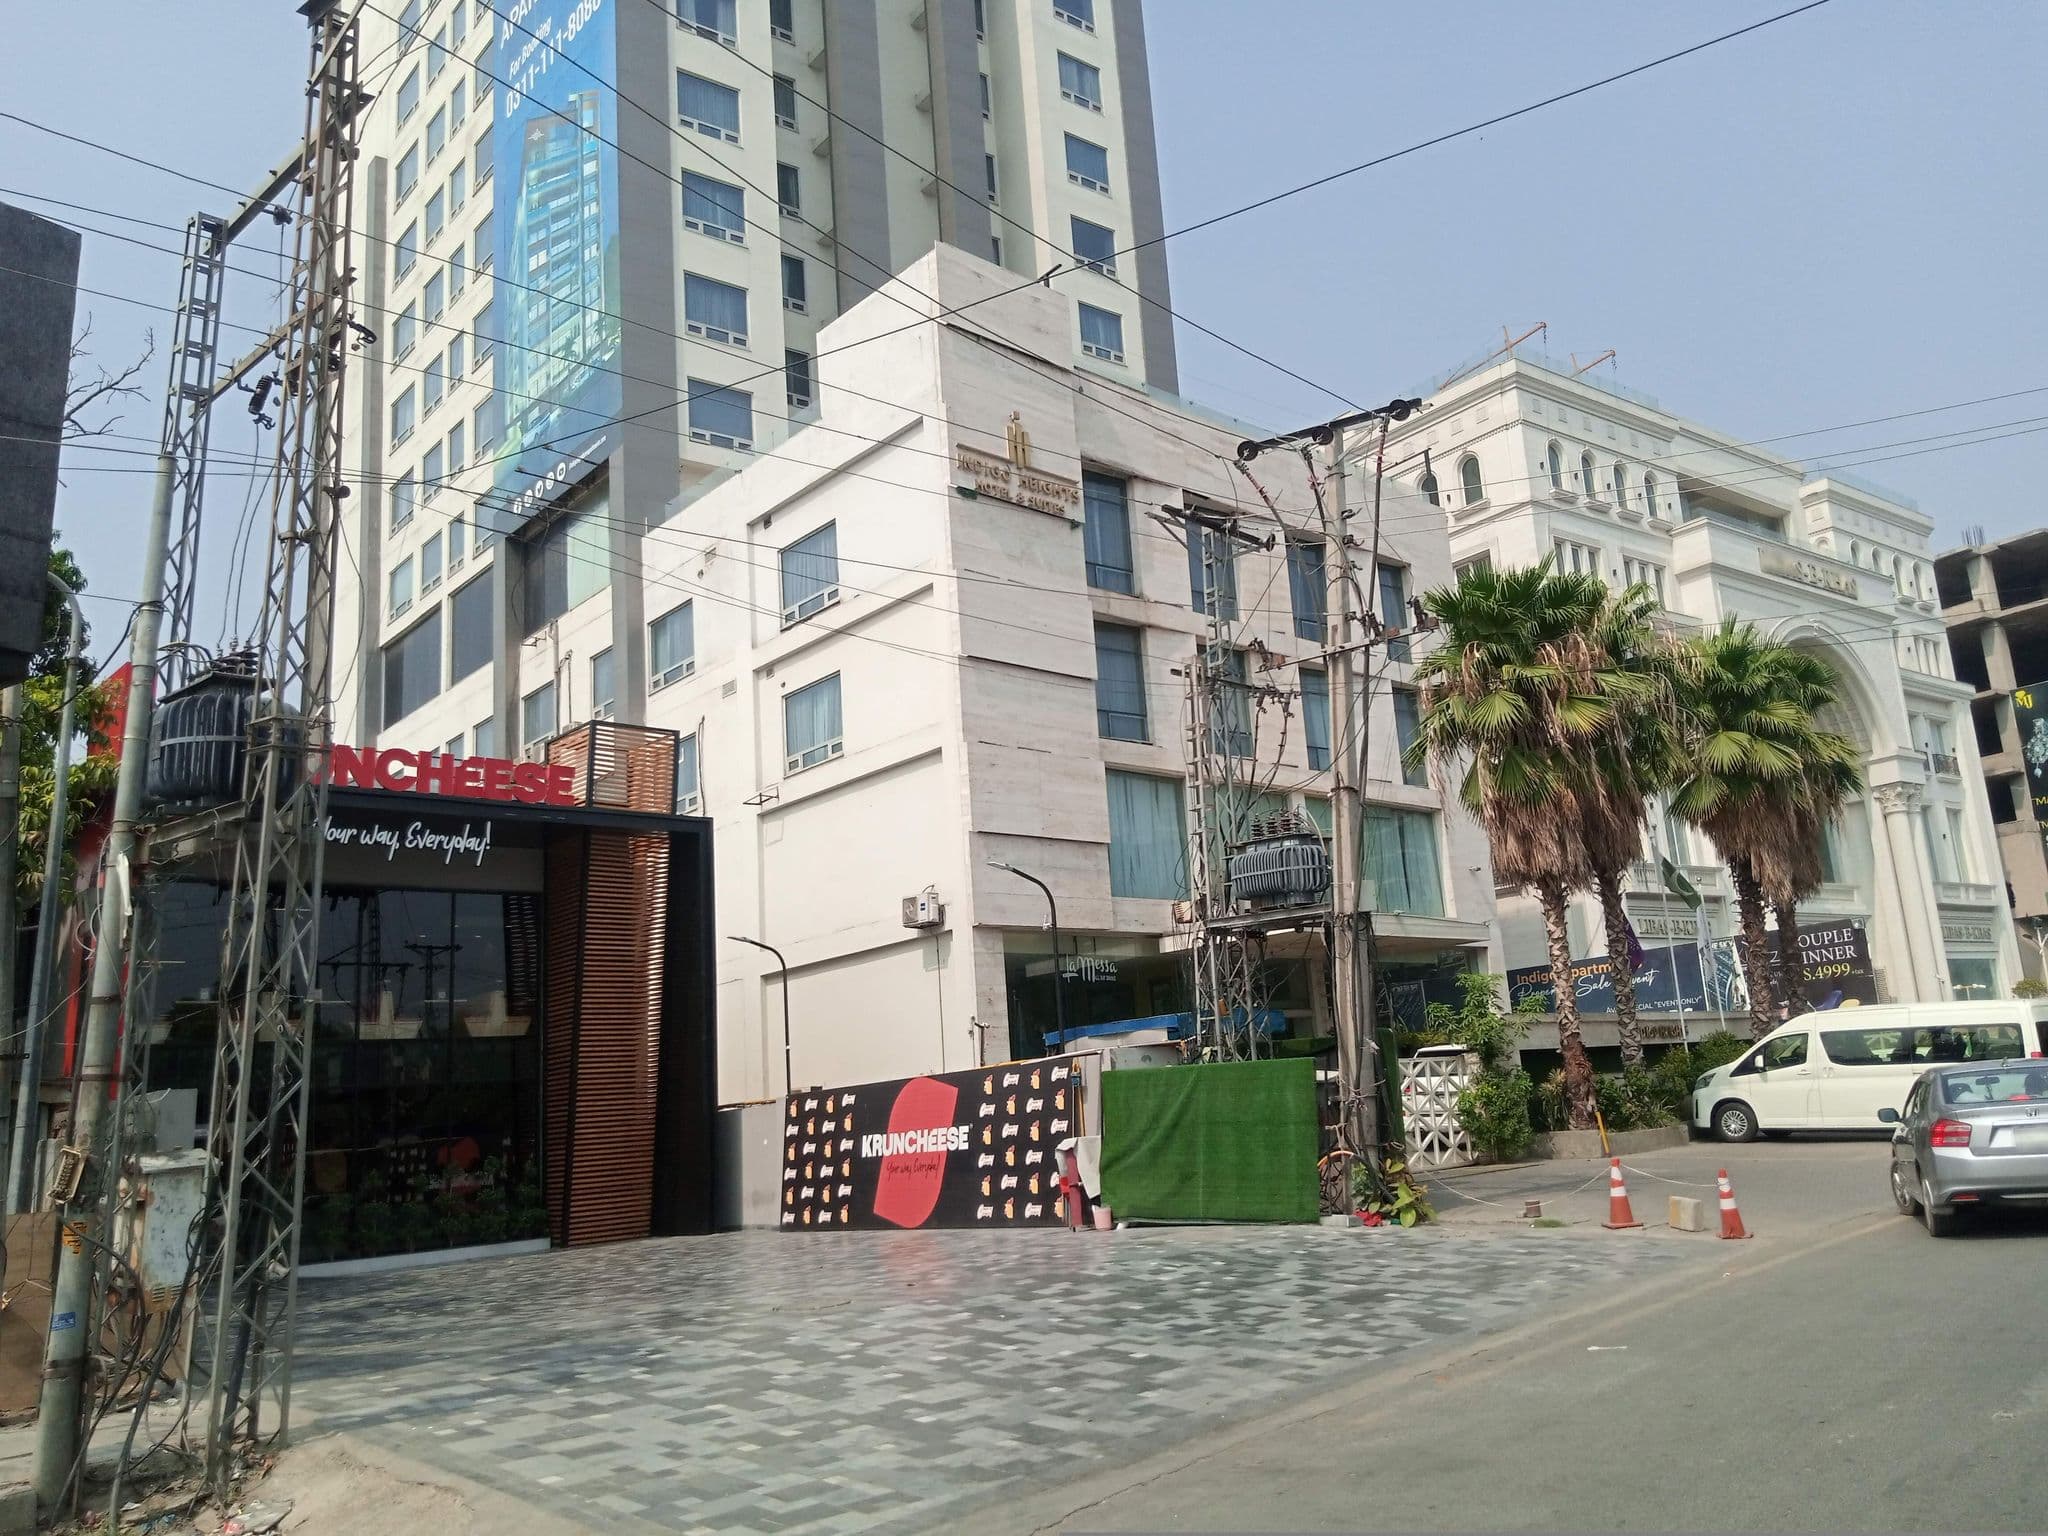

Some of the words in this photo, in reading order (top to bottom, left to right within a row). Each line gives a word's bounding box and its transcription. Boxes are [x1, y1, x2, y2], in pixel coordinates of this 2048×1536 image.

[360, 825, 400, 861] way,
[404, 821, 491, 866] Everyday!
[1797, 928, 1854, 948] OUPLE
[1801, 945, 1858, 965] INNER
[1077, 956, 1118, 983] Messa
[1576, 974, 1612, 996] Sale
[1632, 968, 1660, 987] vent
[1803, 963, 1850, 981] S.4999
[861, 1125, 969, 1158] KRUNCHEESE
